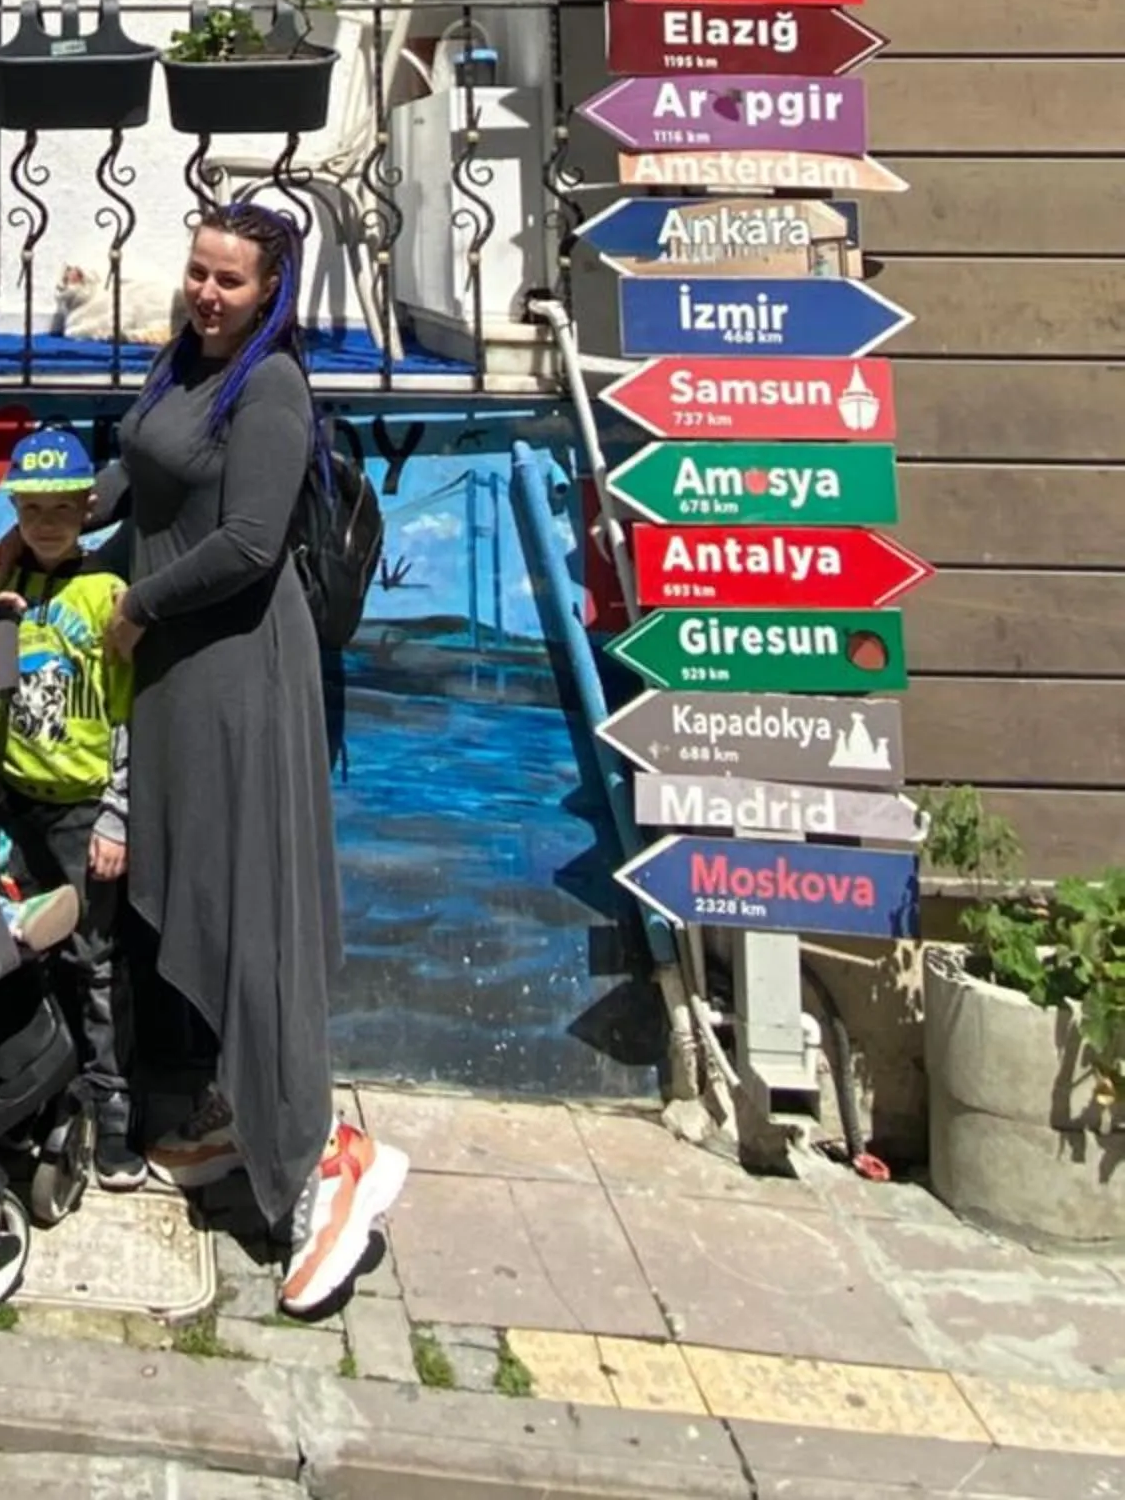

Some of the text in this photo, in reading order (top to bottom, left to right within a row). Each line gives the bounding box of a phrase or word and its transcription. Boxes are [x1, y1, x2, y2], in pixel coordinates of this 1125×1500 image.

[663, 11, 798, 52] Elazığ
[634, 153, 858, 187] Amsterdam
[657, 208, 810, 245] Ankara
[679, 284, 788, 330] İzmir
[670, 370, 832, 405] Samsun
[22, 449, 69, 471] BOY
[662, 536, 842, 580] Antalya
[678, 618, 839, 656] Giresun
[672, 704, 832, 748] Kapadokya
[659, 784, 836, 833] Madrid
[691, 853, 876, 907] Moskova
